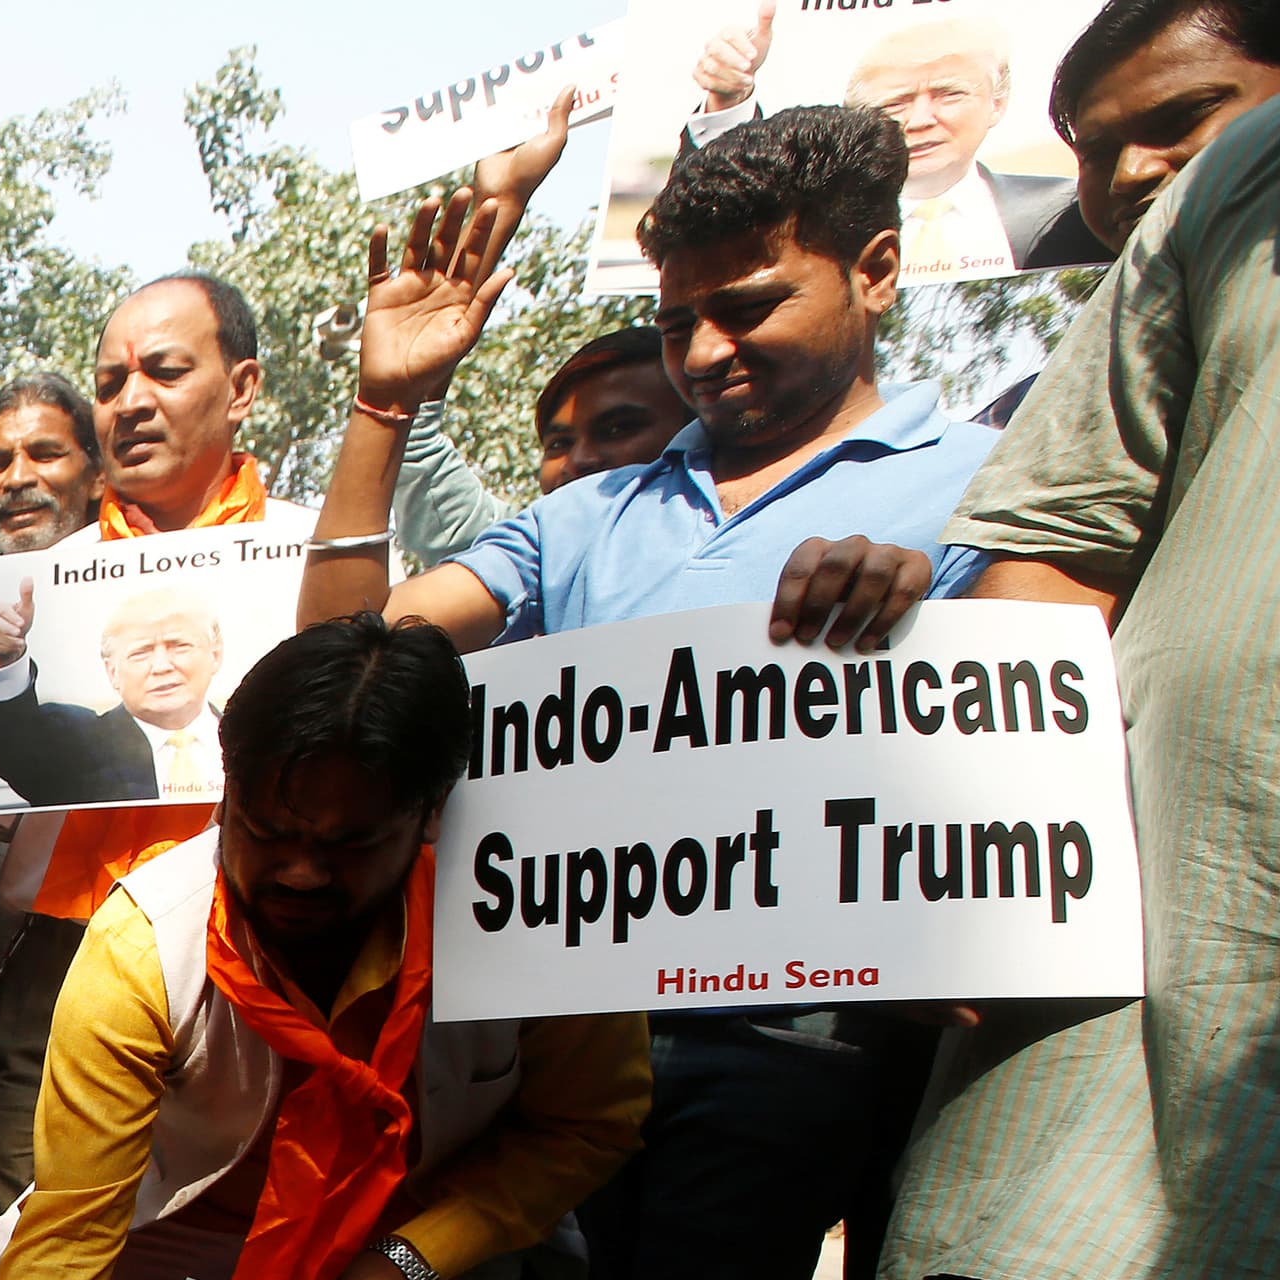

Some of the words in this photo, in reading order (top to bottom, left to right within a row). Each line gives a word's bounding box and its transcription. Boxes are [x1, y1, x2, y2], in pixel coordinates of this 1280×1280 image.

[959, 255, 1005, 270] Sena
[53, 559, 125, 585] India
[139, 549, 221, 574] Loves
[233, 538, 304, 563] Trum
[468, 638, 1089, 780] Indo-Americans
[162, 782, 202, 793] Hindu
[207, 780, 224, 792] Se
[472, 808, 780, 948] Support
[825, 797, 1093, 923] Trump
[656, 964, 770, 995] Hindu
[784, 960, 880, 991] Sena
